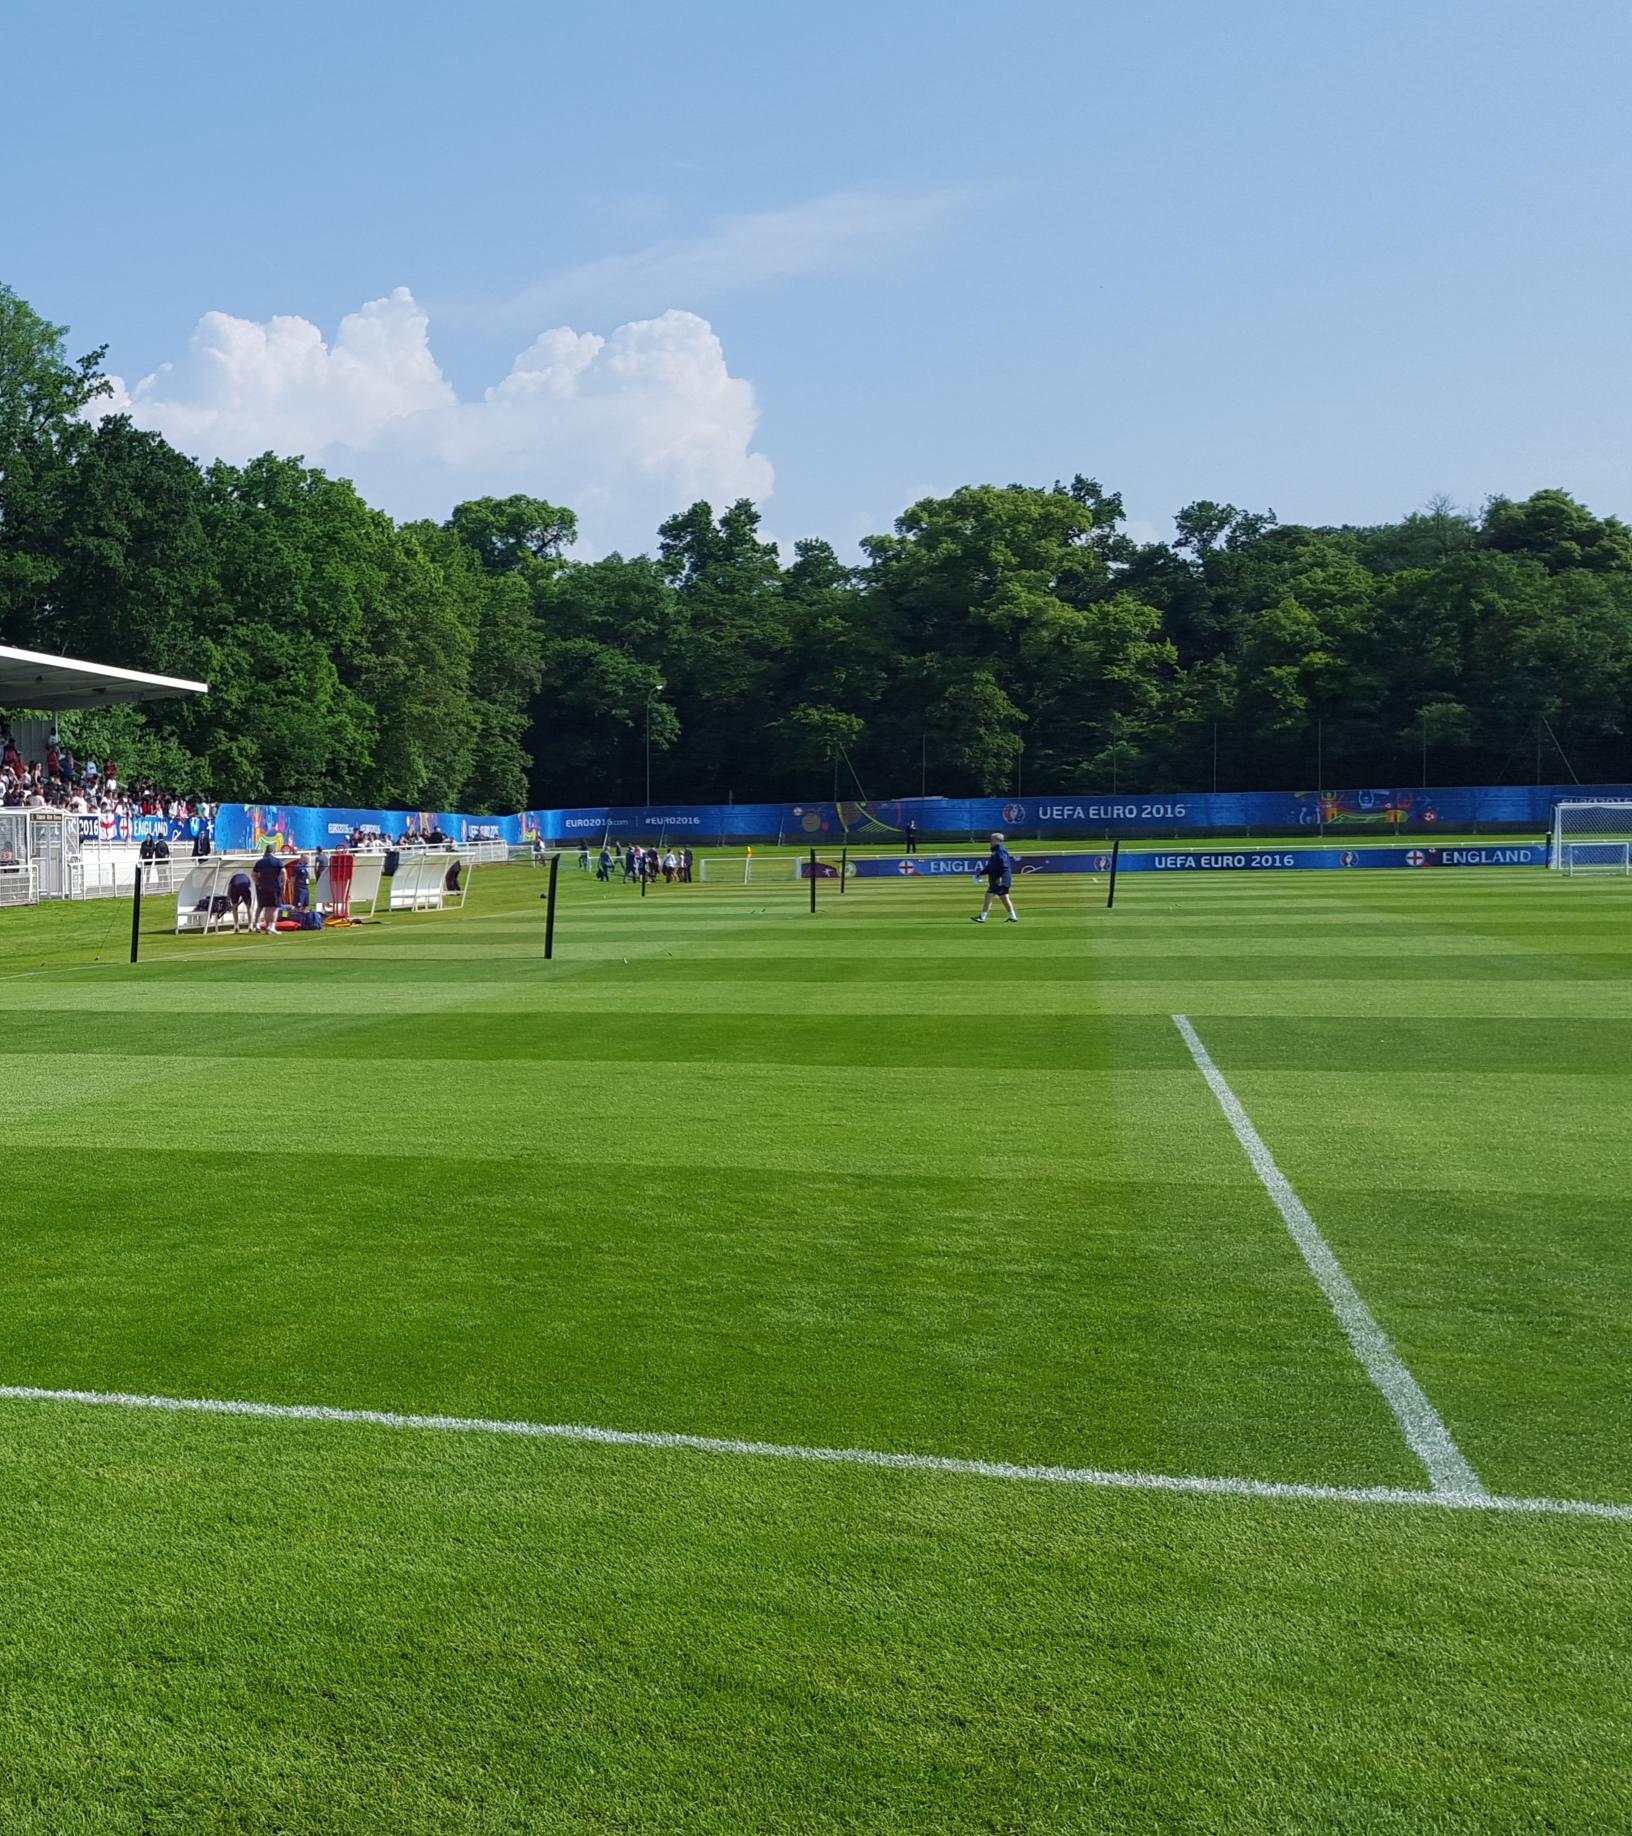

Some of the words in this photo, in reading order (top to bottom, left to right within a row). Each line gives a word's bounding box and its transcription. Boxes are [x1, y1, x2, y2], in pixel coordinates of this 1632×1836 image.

[1039, 806, 1085, 820] UEFA
[1089, 805, 1137, 819] EURO
[1142, 804, 1186, 818] 2016
[79, 819, 99, 835] 2016
[565, 817, 629, 828] EURO2016.com
[645, 816, 700, 825] #EURO2016
[134, 820, 168, 836] ENGLAND
[1155, 856, 1196, 868] UEFA
[1201, 855, 1245, 868] EURO
[1251, 854, 1294, 867] 2016
[1442, 850, 1532, 864] ENGLAND
[930, 860, 989, 873] ENGLA
